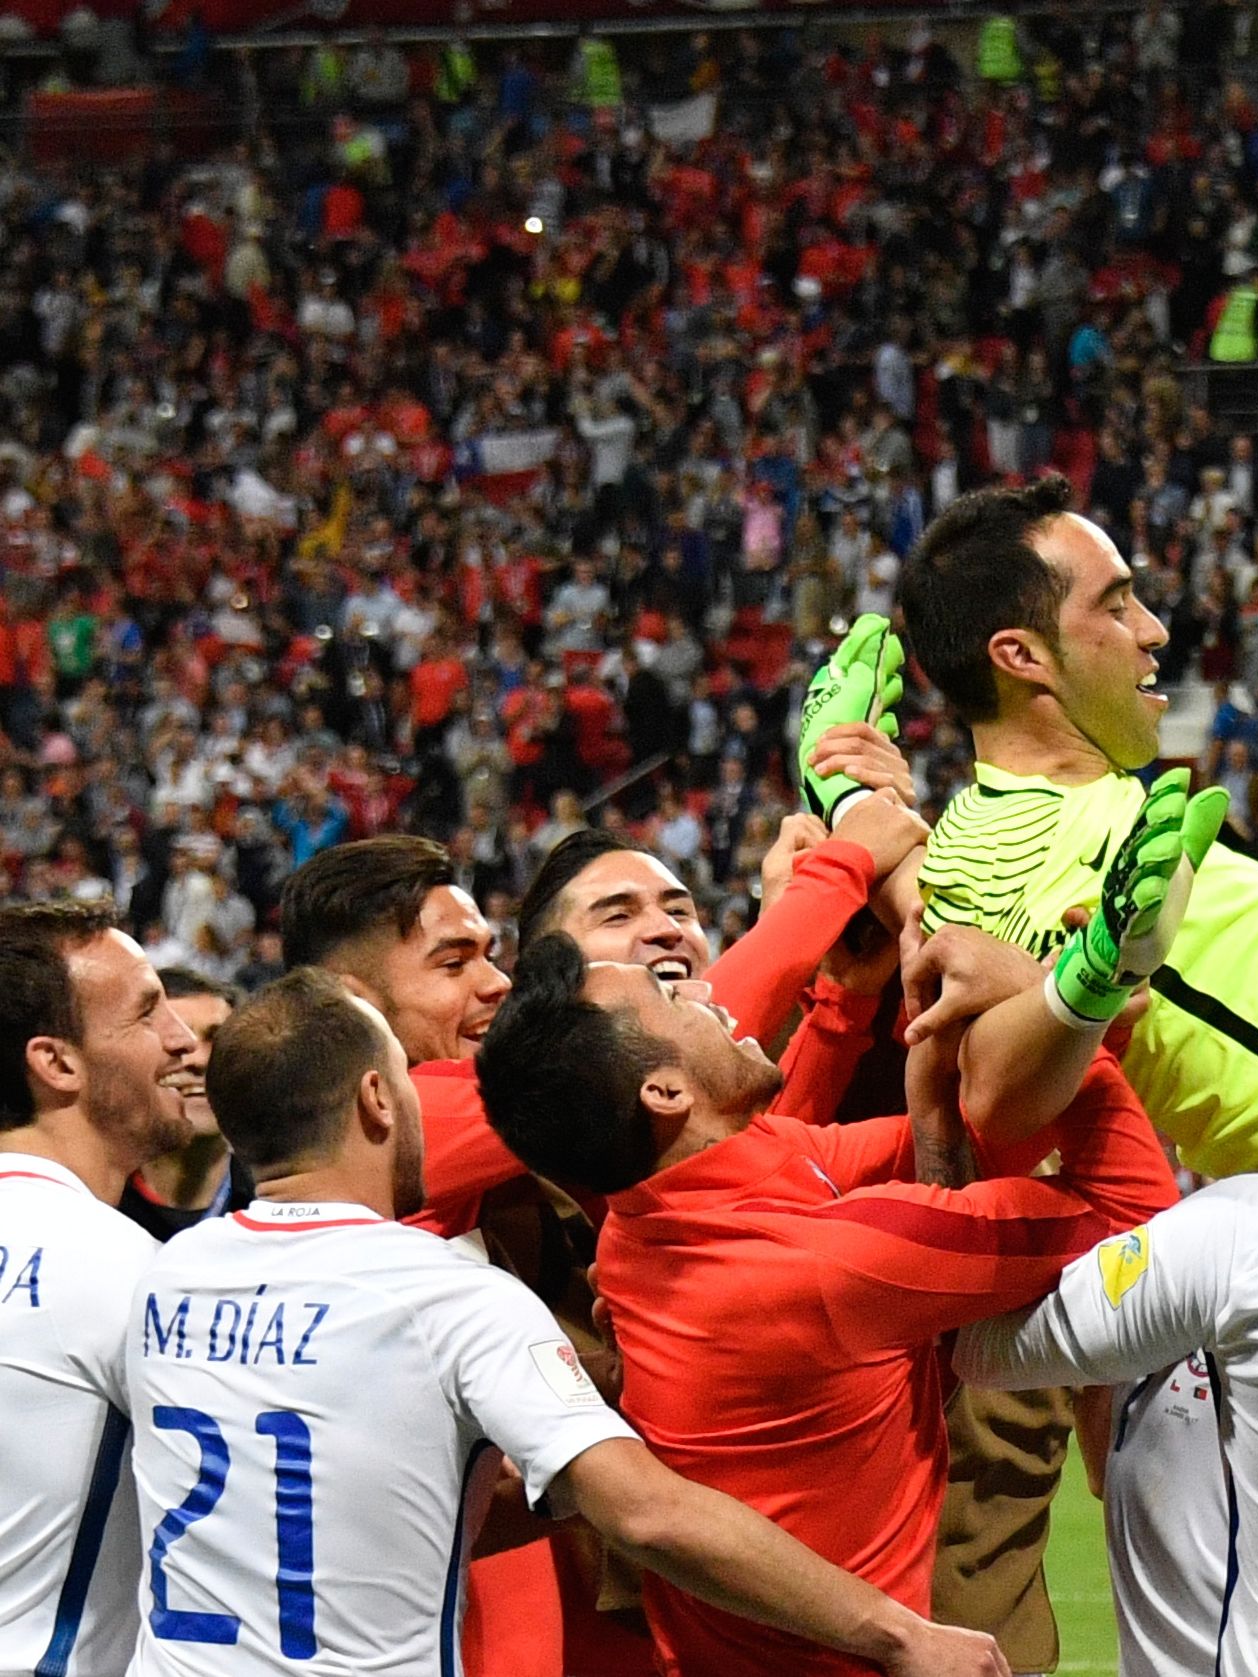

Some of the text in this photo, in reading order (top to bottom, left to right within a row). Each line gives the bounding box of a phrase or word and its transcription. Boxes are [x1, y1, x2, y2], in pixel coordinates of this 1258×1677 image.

[802, 683, 841, 739] didas
[271, 1206, 321, 1218] LA ROJA
[206, 1283, 331, 1366] DÍAZ
[148, 1404, 319, 1661] 21
